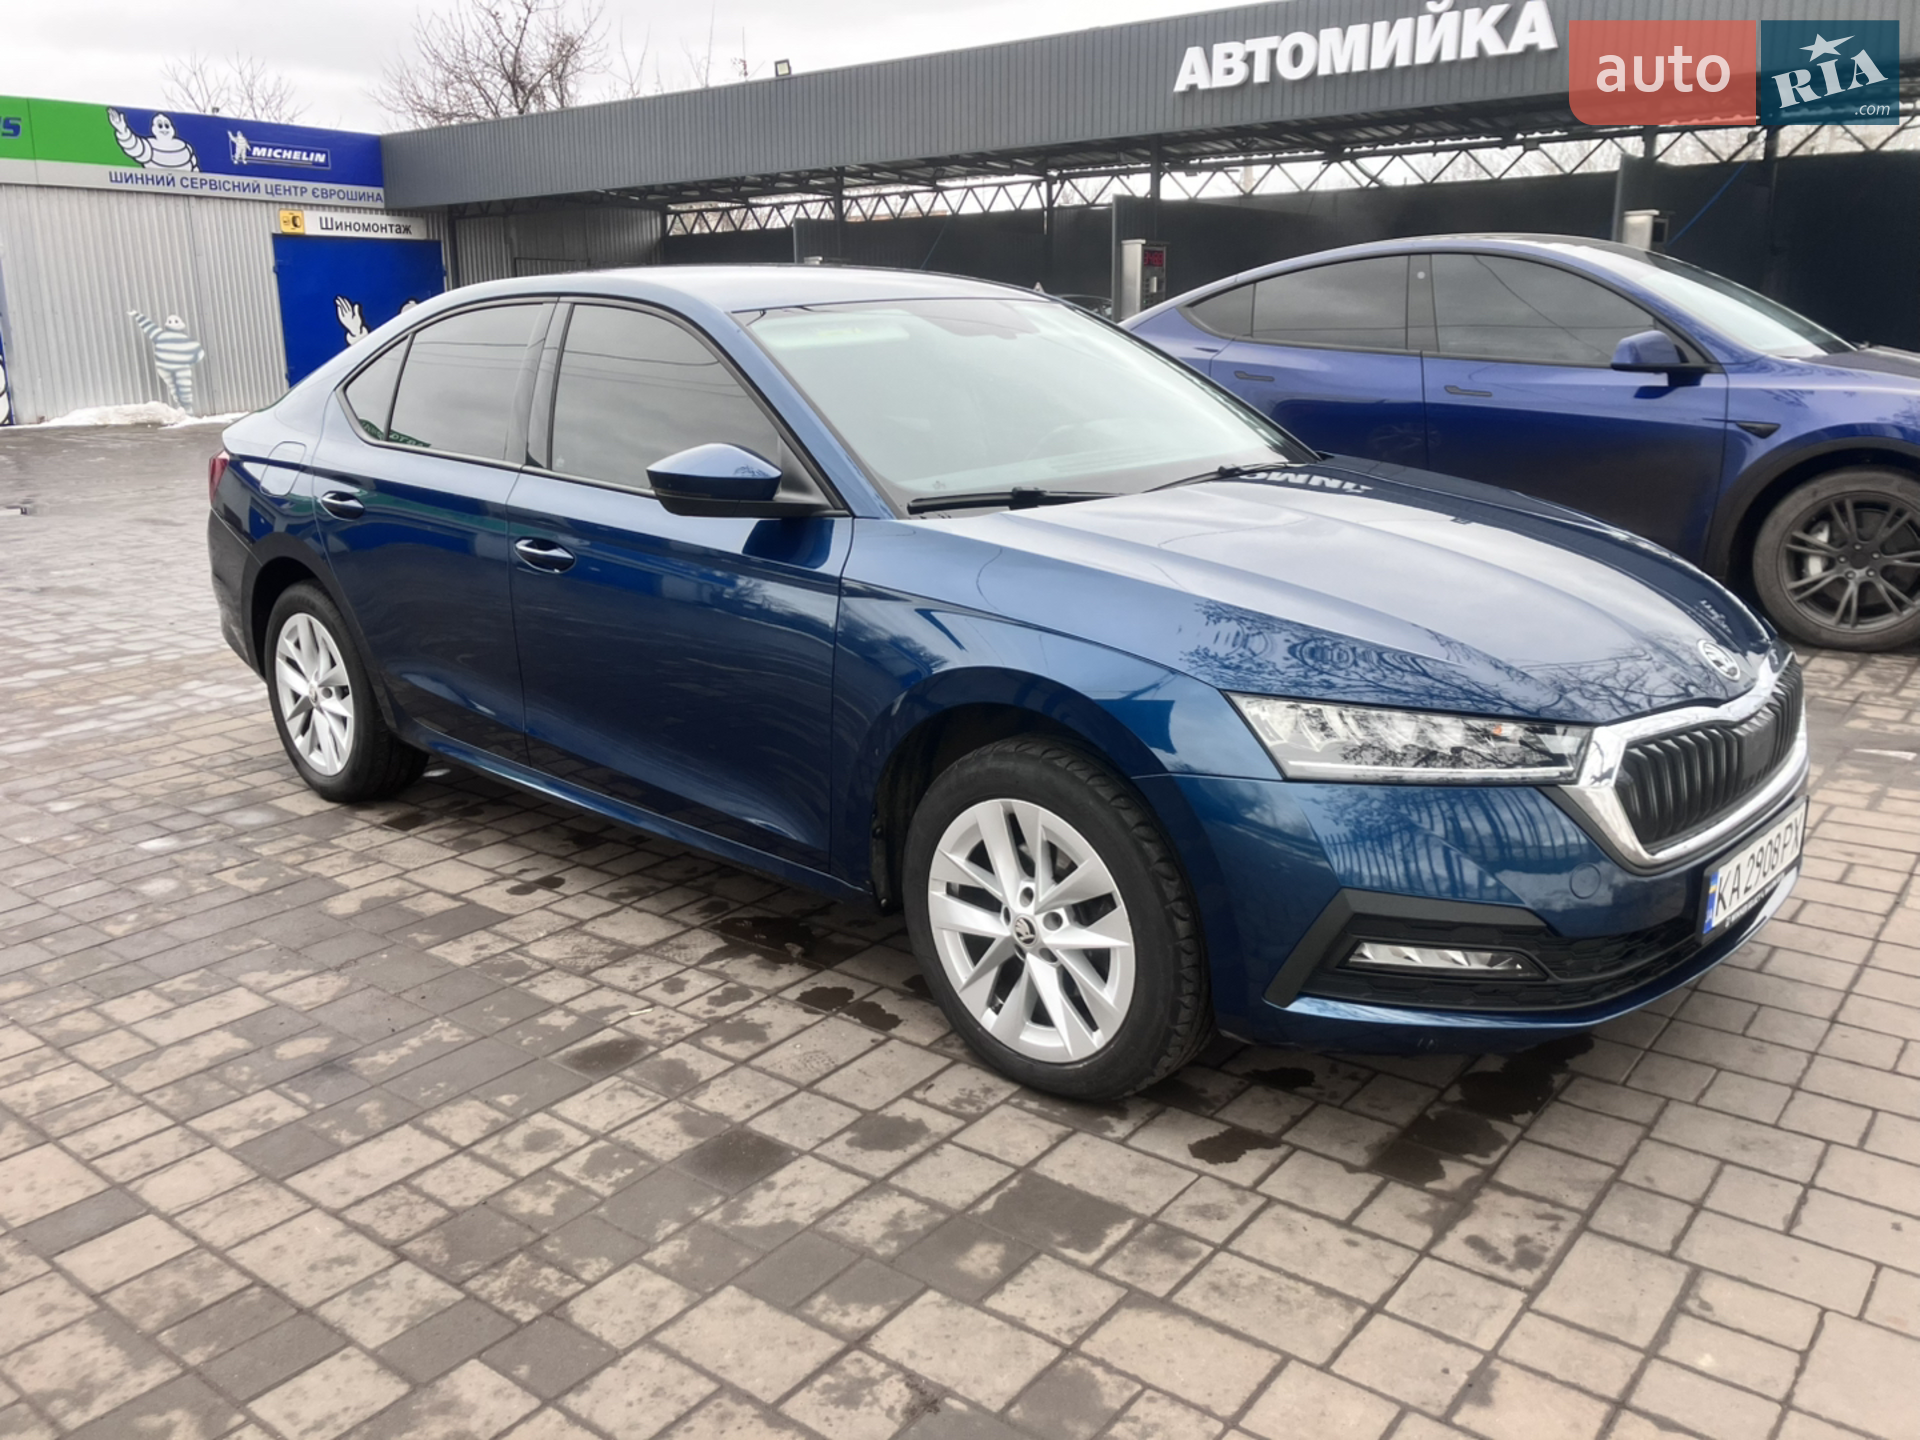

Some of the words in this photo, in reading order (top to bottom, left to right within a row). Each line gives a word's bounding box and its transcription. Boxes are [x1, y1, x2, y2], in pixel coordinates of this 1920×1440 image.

[1173, 0, 1558, 92] АВТОМИЙКА
[0, 116, 22, 138] S
[251, 146, 327, 163] MICHELIN
[108, 171, 176, 188] ШИННИЙ
[180, 176, 261, 194] СЕРВІСНИЙ
[264, 183, 308, 197] ЦЕНТР
[311, 187, 384, 203] ЄВРОШИНА
[319, 216, 413, 235] Шиномонтаж
